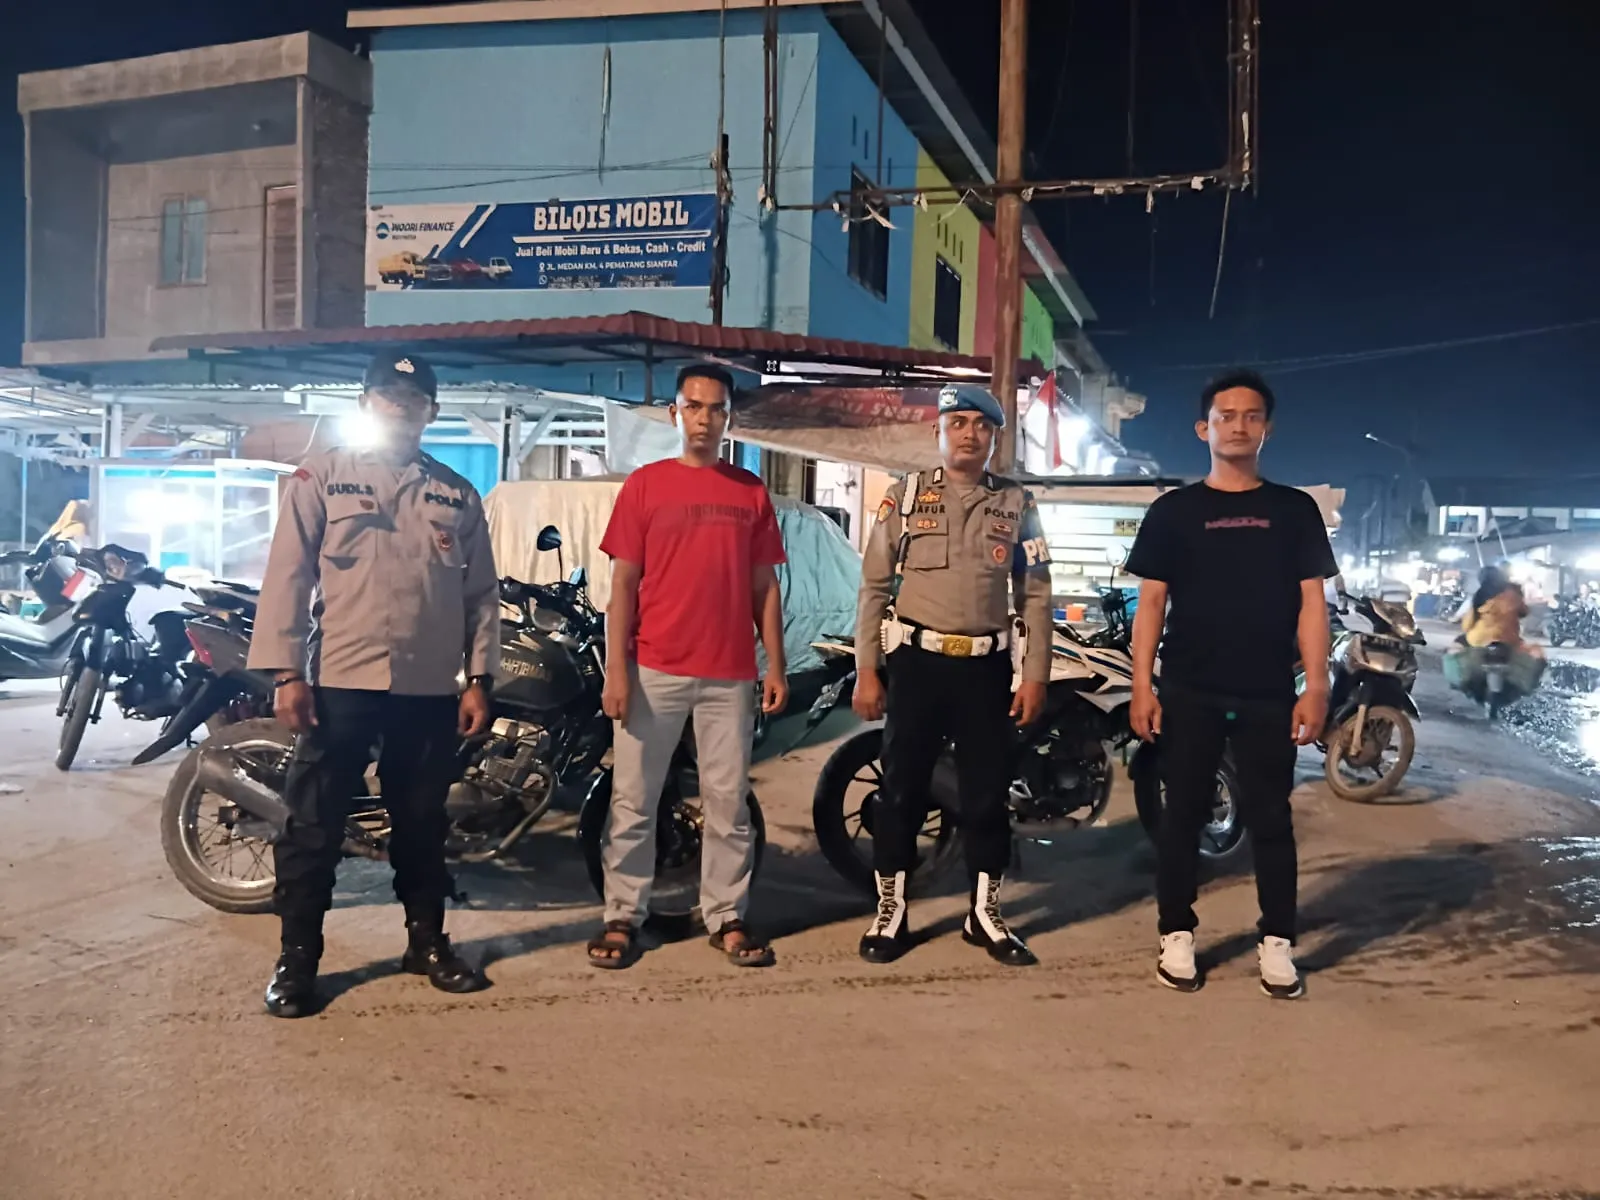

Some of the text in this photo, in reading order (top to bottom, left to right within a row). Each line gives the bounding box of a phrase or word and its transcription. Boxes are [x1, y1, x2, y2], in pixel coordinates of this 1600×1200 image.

[534, 200, 689, 232] BILQIS MOBIL
[419, 221, 455, 232] FINANCE
[515, 247, 534, 257] Jual
[535, 246, 553, 257] Beli
[554, 245, 578, 256] Mobil
[580, 244, 601, 256] Baru
[603, 244, 611, 255] &
[613, 243, 643, 256] Bekas,
[645, 242, 669, 253] Cash
[676, 240, 706, 253] Credit
[557, 262, 584, 270] MEDAN
[605, 261, 645, 269] PEMATANG
[646, 260, 678, 268] SIANTAR
[984, 506, 1019, 522] POLRI
